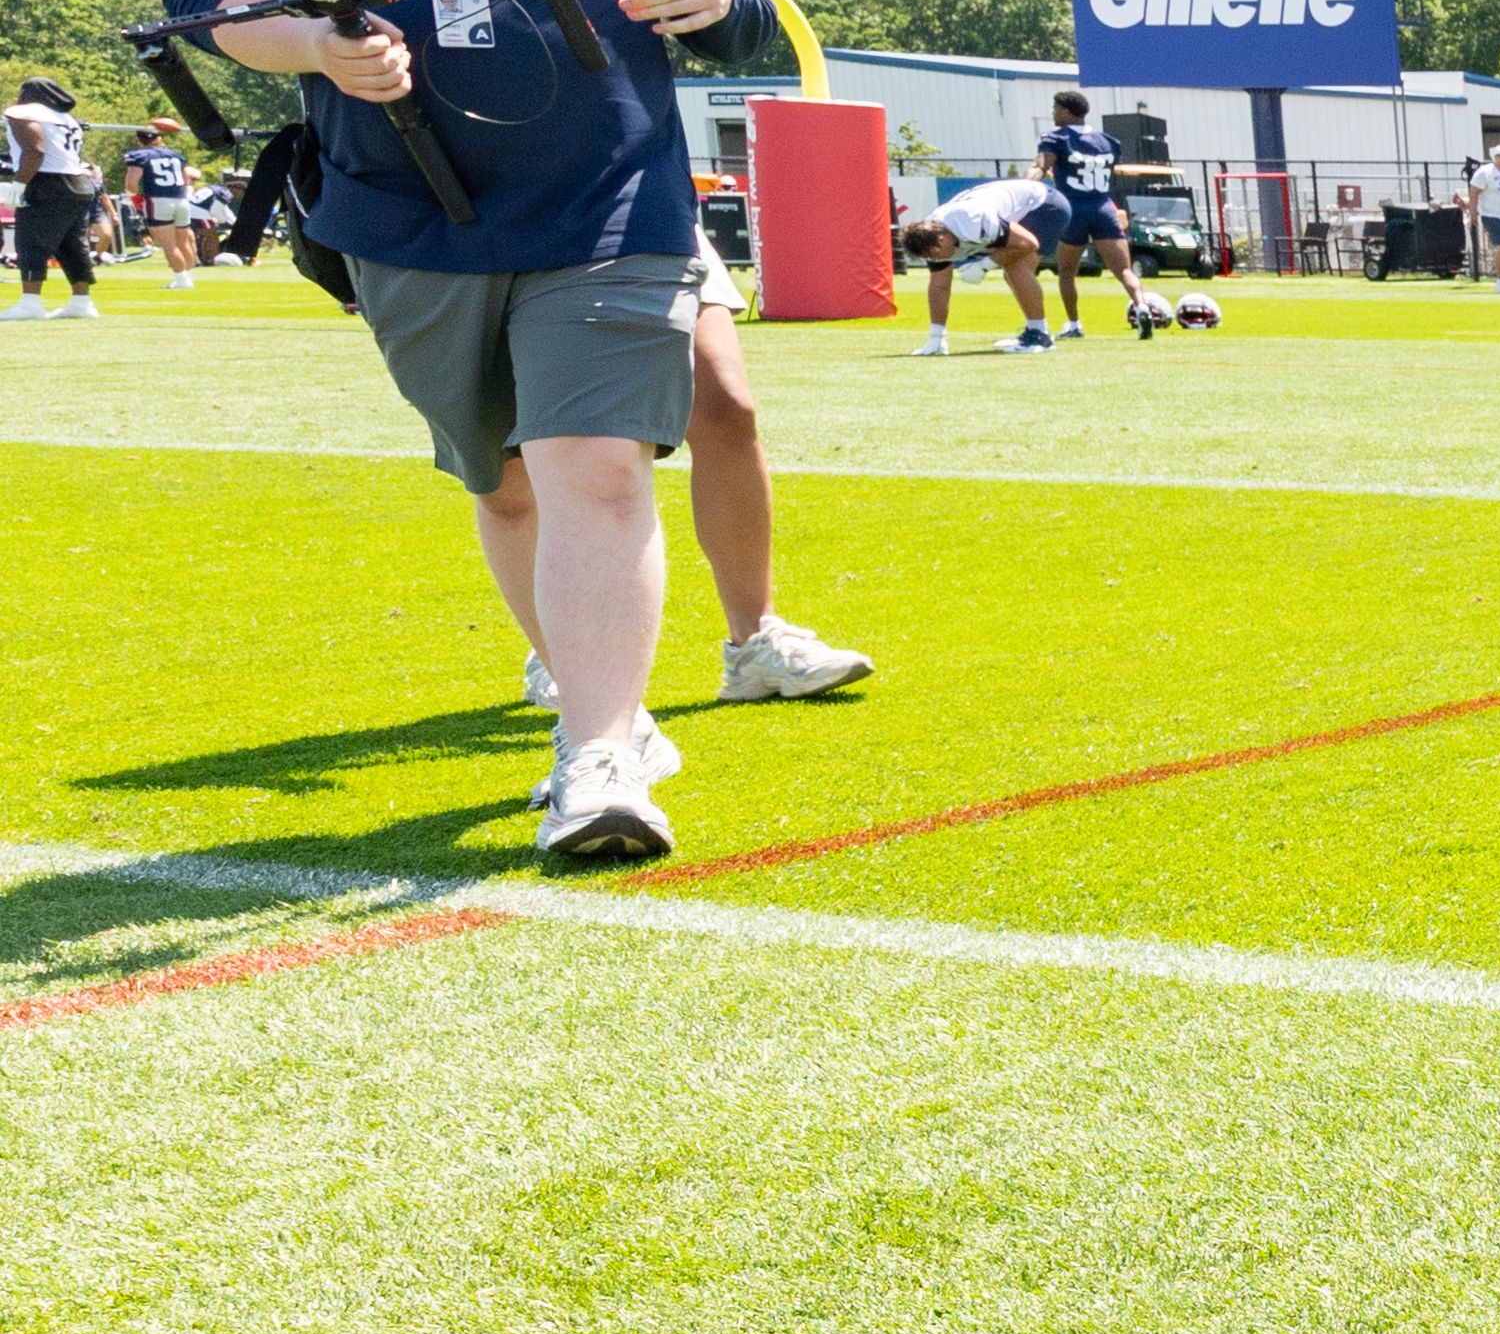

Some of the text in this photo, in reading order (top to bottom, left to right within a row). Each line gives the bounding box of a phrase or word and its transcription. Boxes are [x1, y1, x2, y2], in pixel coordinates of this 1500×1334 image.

[475, 28, 490, 40] A
[150, 157, 185, 187] 51
[1066, 152, 1116, 193] 36
